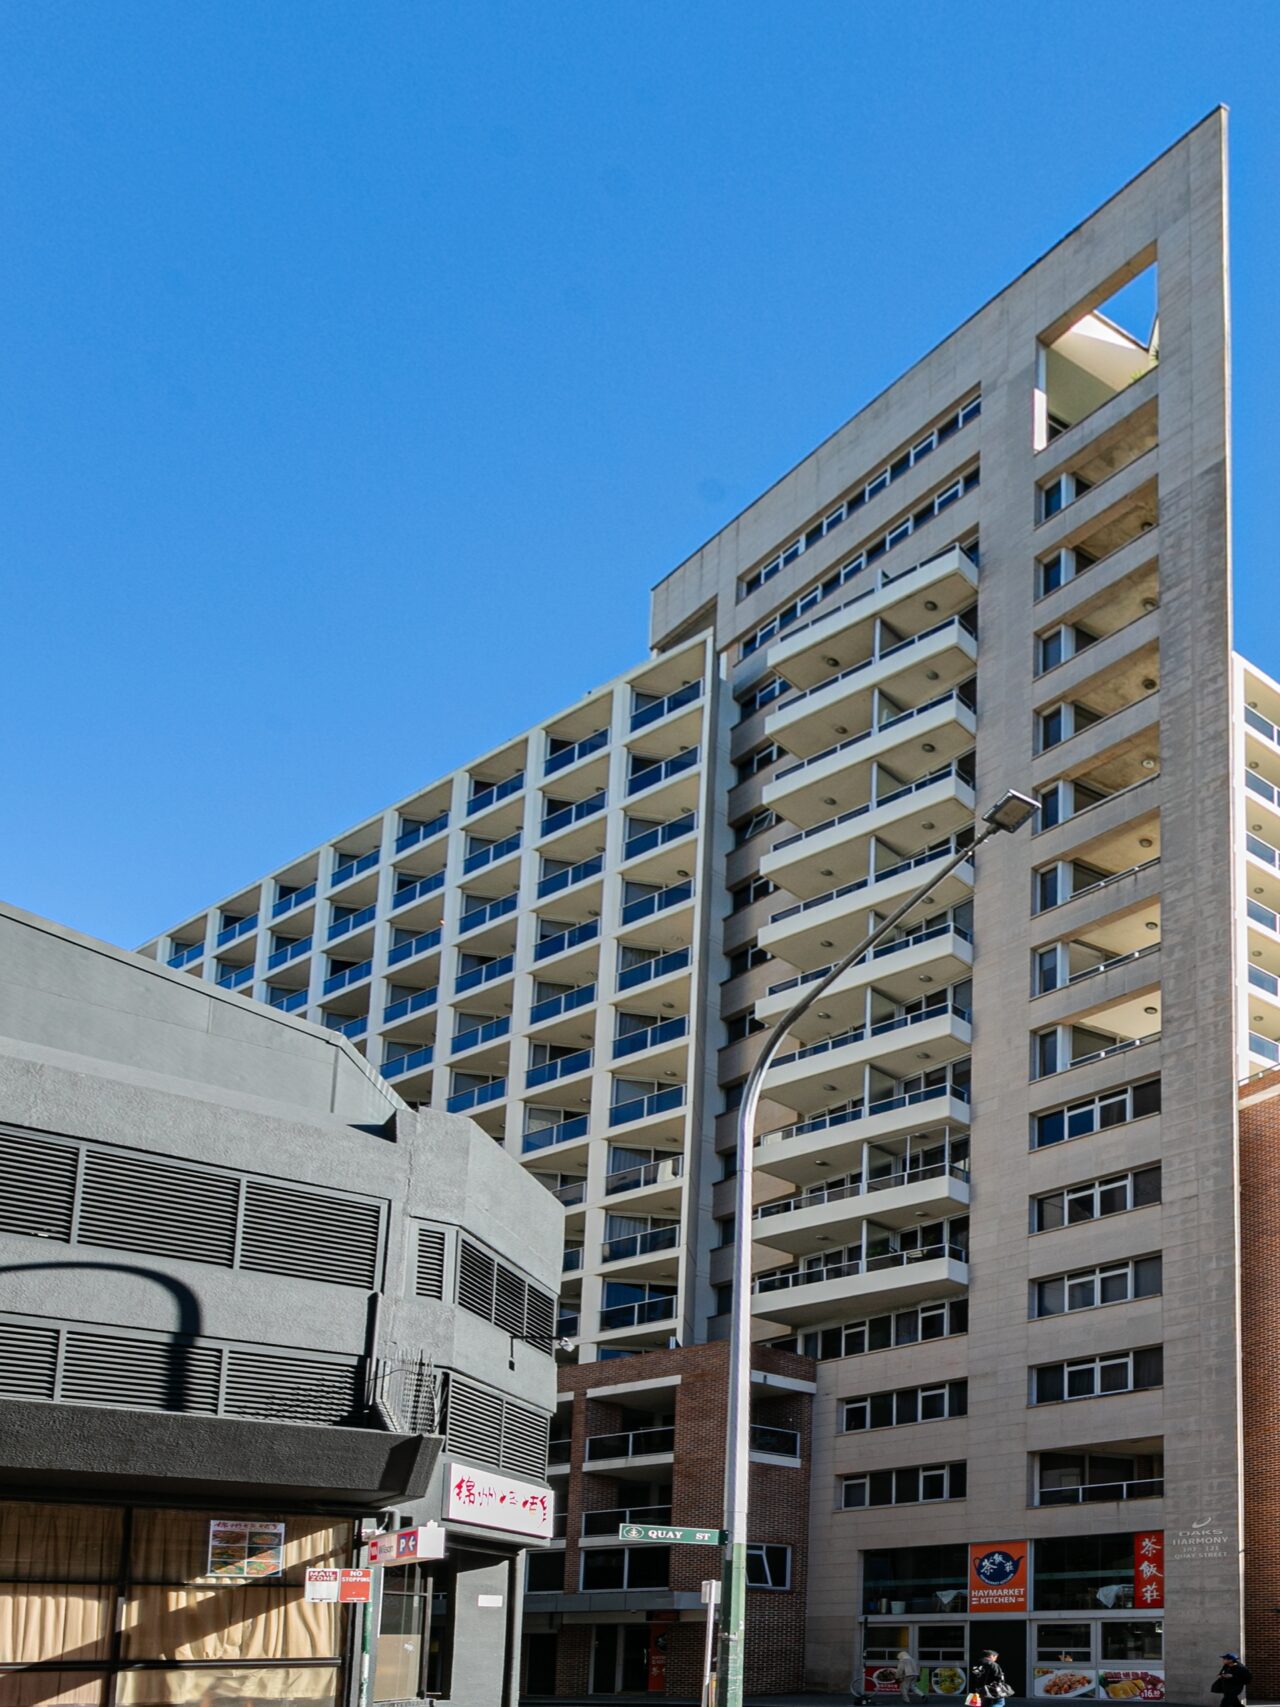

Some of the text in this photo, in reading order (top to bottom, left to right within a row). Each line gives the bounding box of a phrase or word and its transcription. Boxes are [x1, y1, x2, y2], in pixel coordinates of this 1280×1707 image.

[647, 1529, 711, 1541] QUAY ST
[1178, 1528, 1224, 1537] OAKS
[1172, 1536, 1229, 1546] HARMONY
[1198, 1551, 1228, 1559] STREET
[971, 1588, 1025, 1597] HAYMARKET
[980, 1596, 1016, 1604] KITCHEN
